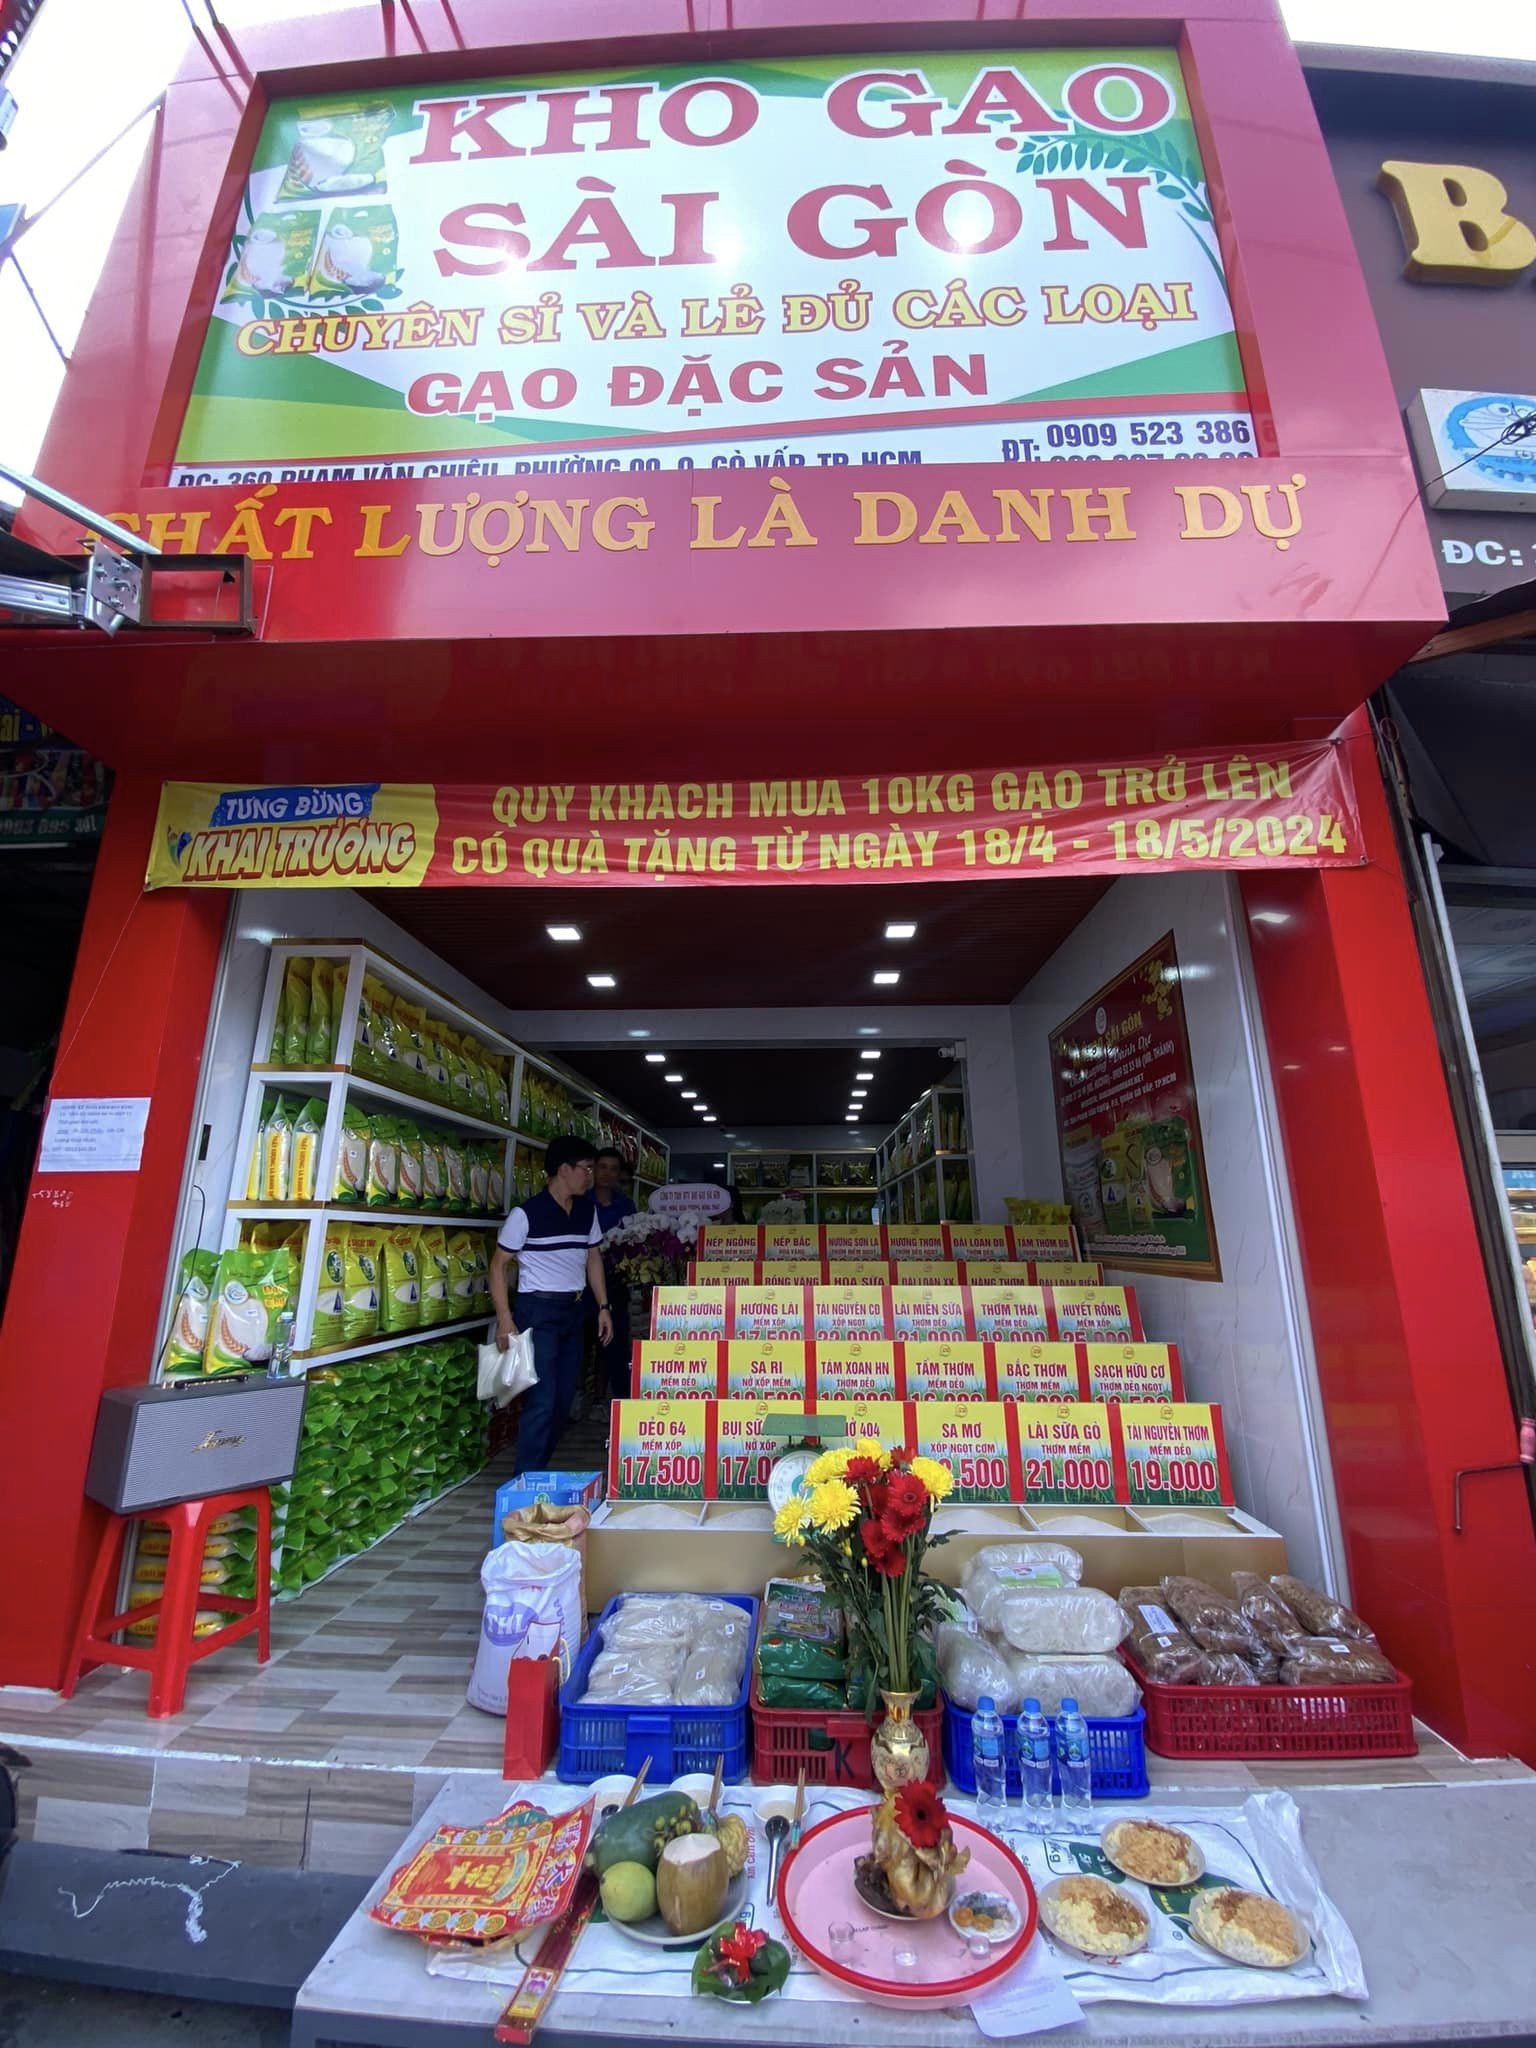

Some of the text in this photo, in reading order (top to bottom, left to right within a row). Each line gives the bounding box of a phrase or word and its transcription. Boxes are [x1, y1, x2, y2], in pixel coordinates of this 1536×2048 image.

[409, 66, 1171, 165] KHO GẠO
[433, 159, 1151, 277] SÀI GÒN
[235, 278, 1197, 357] CHUYÊN SỈ VÀ LẺ ĐỦ CÁC LOẠI
[407, 340, 989, 421] GẠO ĐẶC SẢN
[1047, 423, 1117, 447] 0909
[1131, 421, 1184, 446] 523
[1196, 420, 1250, 444] 386
[353, 489, 656, 568] LƯỢNG
[690, 476, 818, 550] LÀ
[853, 488, 1136, 545] DANH
[1174, 474, 1306, 551] DỰ
[1442, 538, 1525, 567] ĐC:
[750, 780, 847, 817] MUA
[867, 774, 974, 815] 10KG
[991, 769, 1083, 819] GẠO
[1097, 755, 1188, 806] TRỞ
[1202, 753, 1294, 800] LÊN
[182, 827, 272, 882] KHAI
[451, 831, 508, 875] CÓ
[521, 830, 609, 878] QUÀ
[623, 829, 737, 881] TẶNG
[751, 826, 811, 872] TỪ
[820, 824, 939, 870] NGÀY
[957, 824, 1056, 866] 18/4
[1108, 814, 1347, 861] 18/5/2024
[741, 1303, 778, 1315] HƯƠNG
[981, 1302, 1011, 1316] THƠM
[650, 1360, 684, 1374] THƠM
[751, 1360, 783, 1374] SA RI
[845, 1361, 872, 1375] XOAN
[875, 1361, 889, 1375] HN
[943, 1361, 975, 1376] THƠM
[1034, 1363, 1067, 1377] THƠM
[639, 1415, 686, 1436] DẺO 64
[722, 1420, 742, 1439] BỤI
[860, 1421, 880, 1437] 404
[942, 1422, 982, 1438] SA MƠ
[1144, 1422, 1180, 1440] NGUYÊN
[1182, 1425, 1209, 1440] THƠM
[622, 1455, 701, 1485] 17.500
[1026, 1458, 1111, 1489] 21.000
[1131, 1459, 1216, 1490] 19.000
